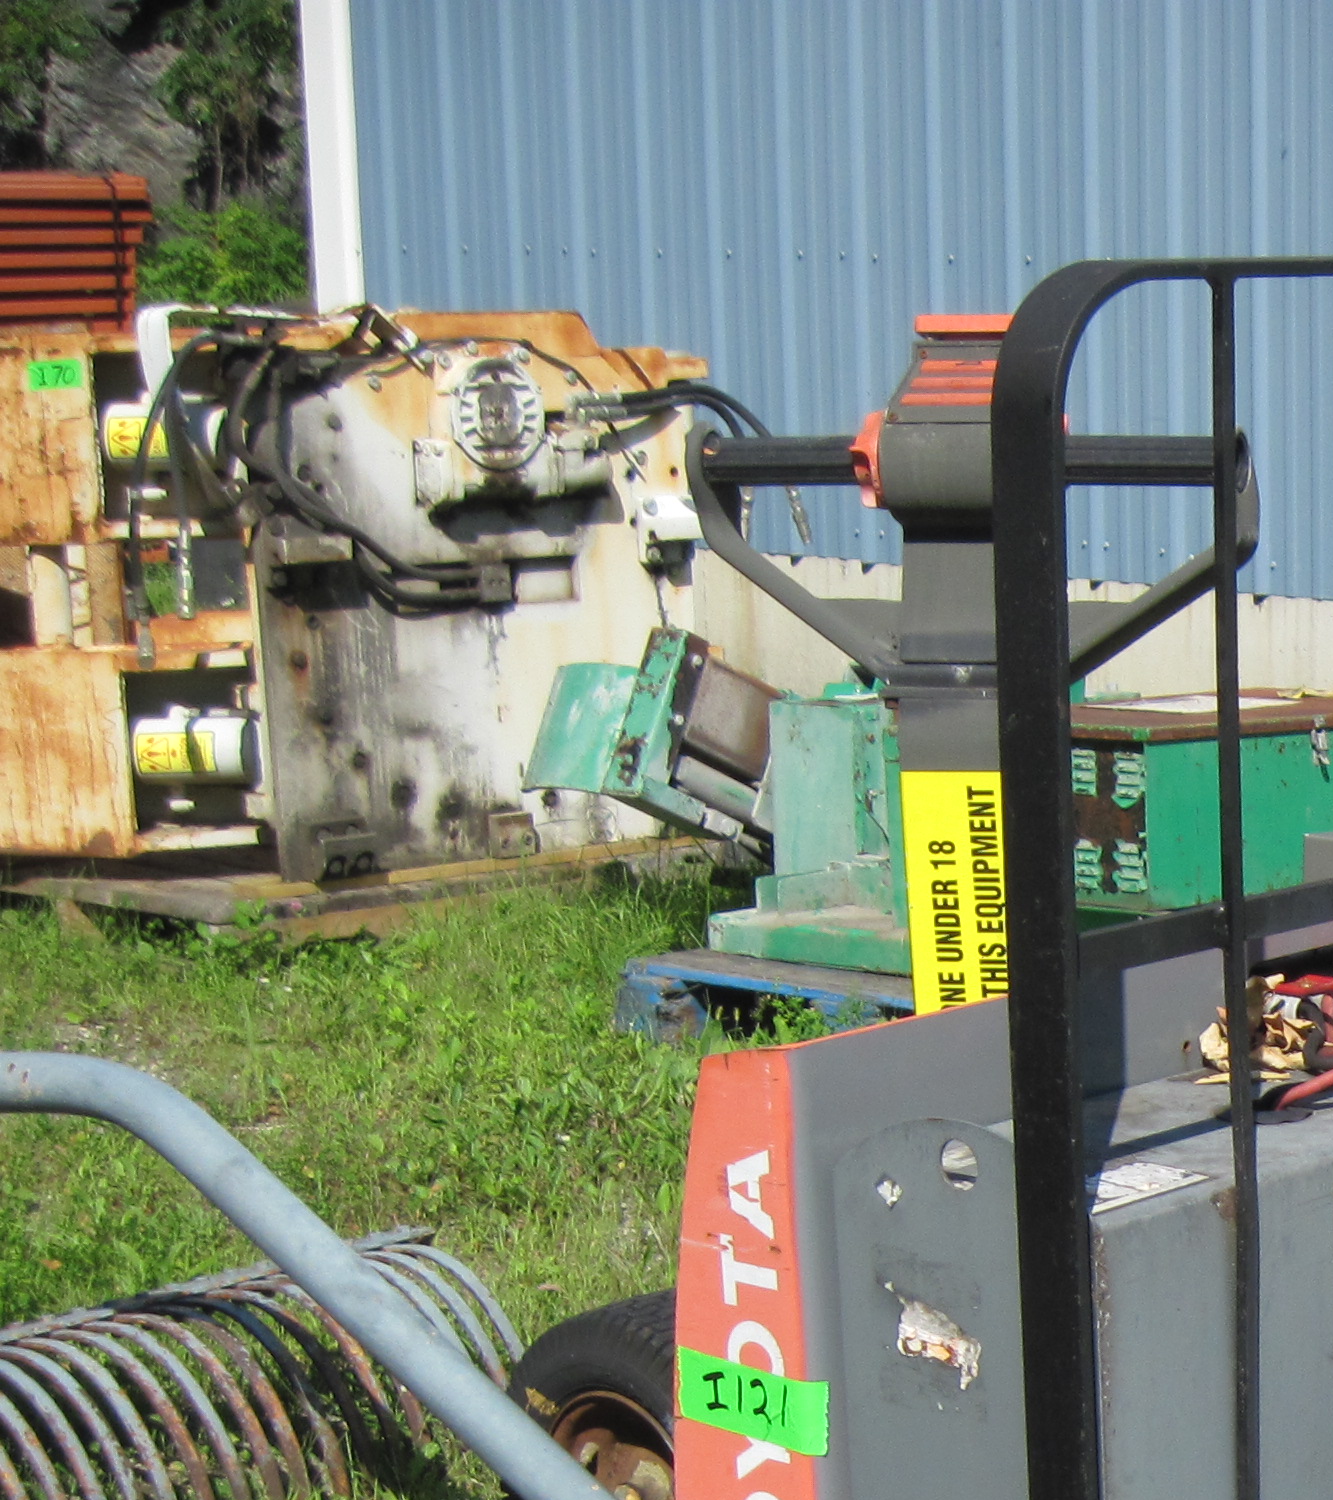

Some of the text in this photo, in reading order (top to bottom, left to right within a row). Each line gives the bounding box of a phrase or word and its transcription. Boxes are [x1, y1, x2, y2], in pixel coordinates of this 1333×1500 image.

[928, 839, 966, 1011] NE UNDER 18
[966, 785, 1008, 999] THIS EQUIPMENT
